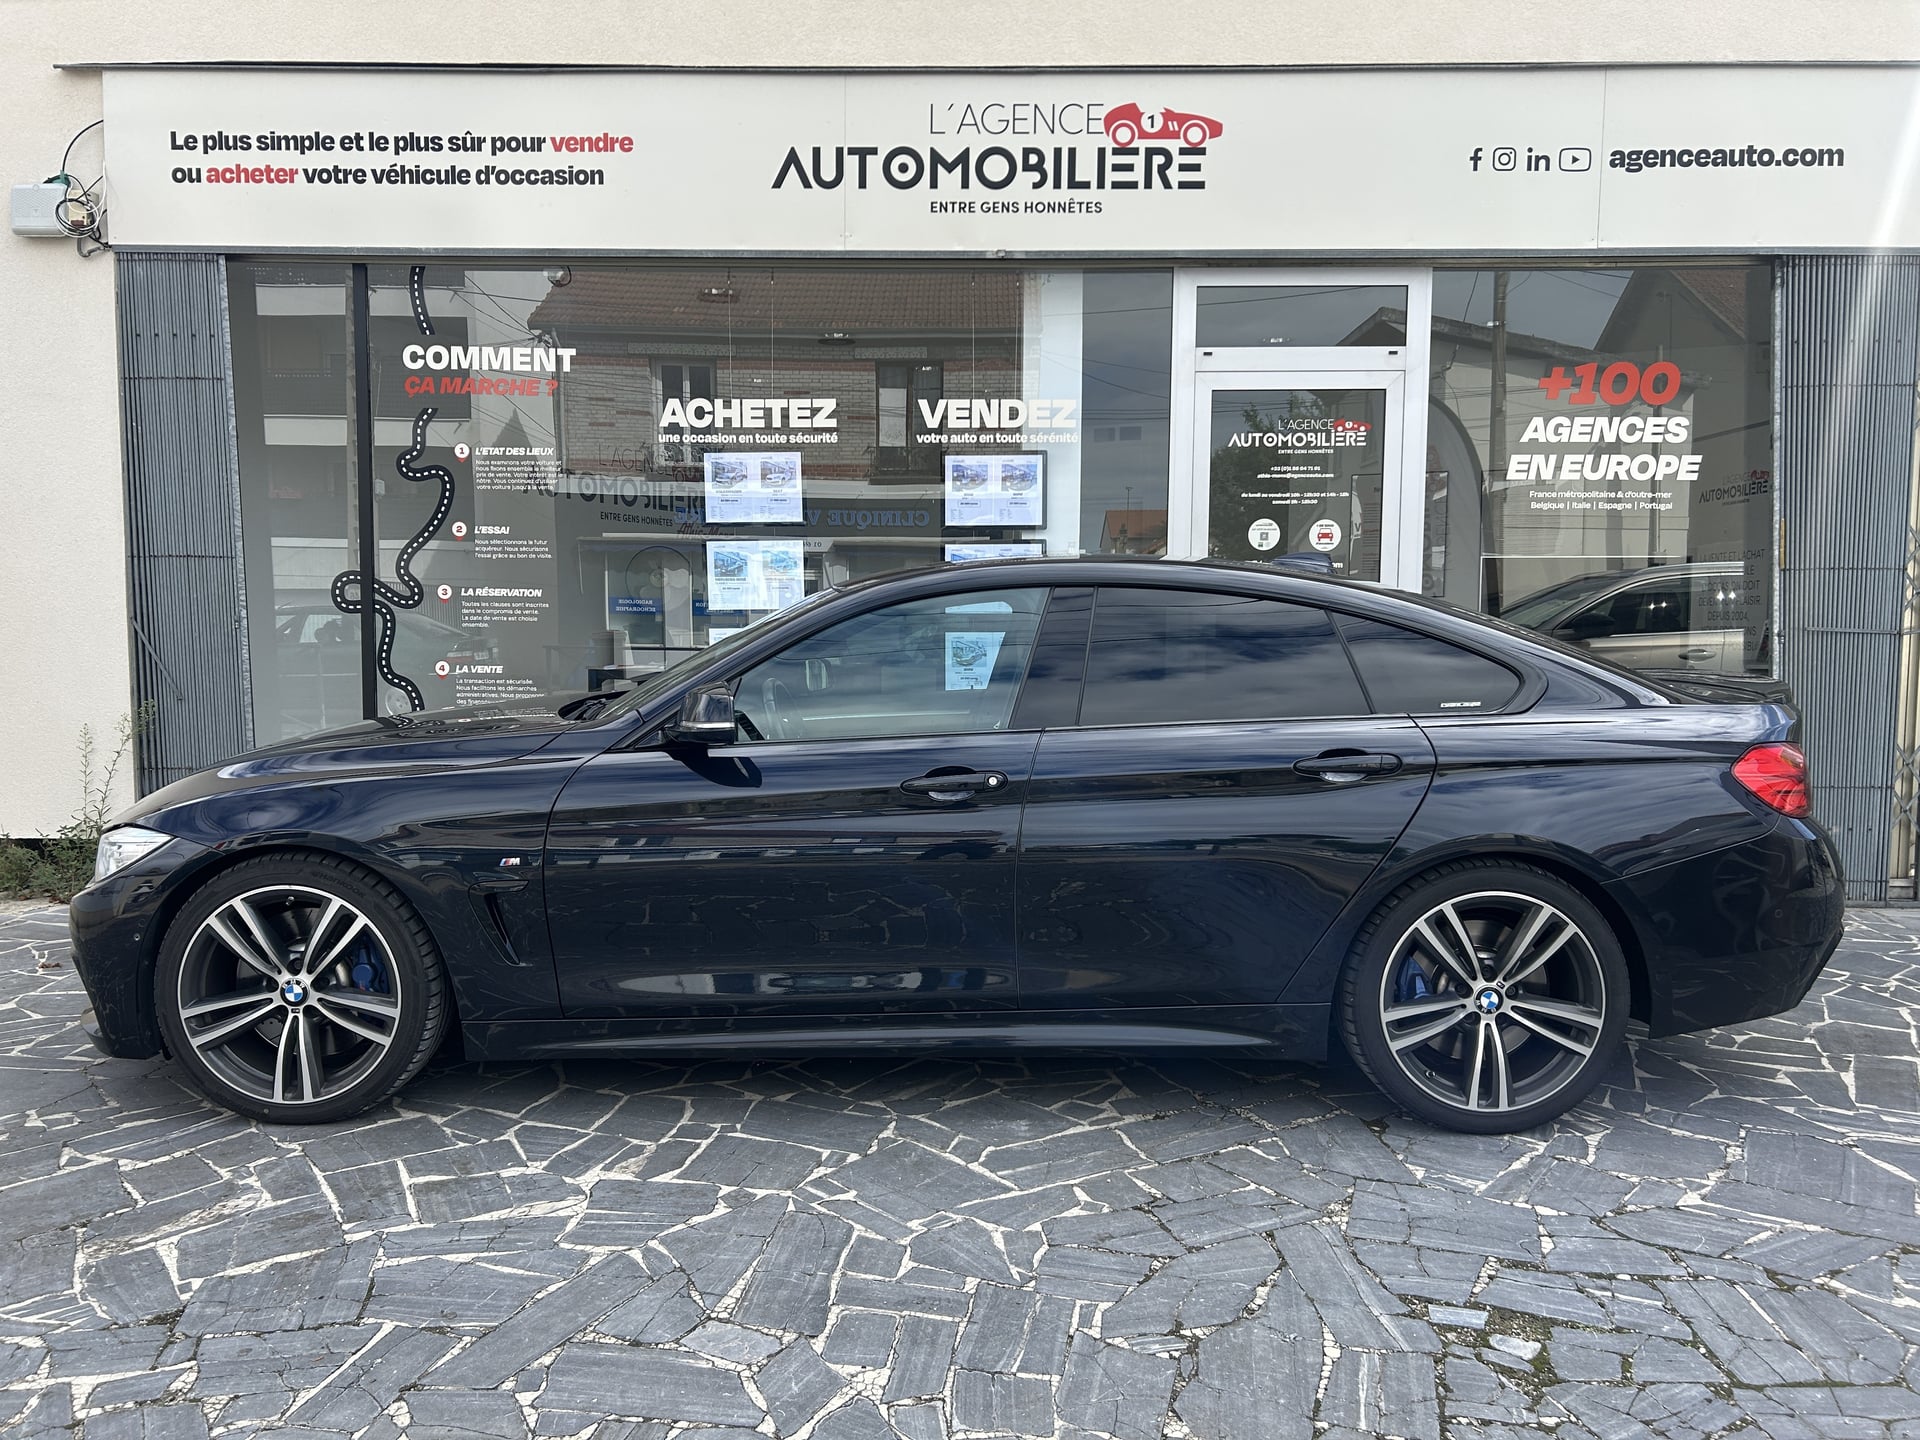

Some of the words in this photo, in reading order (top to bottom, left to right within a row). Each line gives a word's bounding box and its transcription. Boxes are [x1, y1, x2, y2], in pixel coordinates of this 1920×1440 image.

[930, 103, 1104, 135] L'AGENCE
[170, 130, 198, 151] Le
[202, 130, 252, 155] plus
[256, 130, 335, 155] simple
[339, 133, 364, 152] et
[368, 131, 389, 152] le
[394, 130, 443, 155] plus
[448, 130, 486, 153] sûr
[491, 135, 546, 157] pour
[550, 132, 634, 154] vendre
[1609, 145, 1845, 173] agenceauto.com
[171, 167, 202, 185] ou
[206, 164, 299, 185] acheter
[303, 166, 367, 185] votre
[372, 162, 471, 185] véhicule
[475, 164, 604, 186] d'occasion
[930, 201, 976, 214] ENTRE
[980, 201, 1020, 214] GENS
[1023, 198, 1103, 214] HONNÊTES
[402, 345, 577, 372] COMMENT
[404, 376, 435, 398] ÇA
[440, 377, 541, 396] MARCHE
[1538, 361, 1682, 406] +100
[658, 398, 838, 429] ACHETEZ
[916, 399, 1078, 429] VENDEZ
[1278, 419, 1334, 430] L'AGENCE
[1520, 416, 1690, 443] AGENCES
[658, 434, 681, 443] une
[683, 433, 737, 443] occasion
[739, 434, 753, 443] en
[755, 433, 787, 443] toute
[789, 432, 839, 443] sécurité
[916, 434, 948, 443] votre
[950, 434, 978, 443] auto
[980, 434, 994, 443] en
[995, 433, 1028, 443] toute
[1029, 432, 1079, 443] sérénité
[505, 447, 525, 455] DES
[526, 447, 554, 455] LIEUX
[1506, 454, 1558, 481] EN
[1559, 454, 1703, 481] EUROPE
[1529, 490, 1557, 498] France
[1558, 490, 1615, 499] métropolitaine
[1616, 490, 1624, 498] &
[1625, 490, 1672, 498] d'outre-mer
[1530, 501, 1565, 510] Belgique
[1571, 501, 1591, 510] Italie
[1598, 501, 1632, 510] Espagne
[1639, 501, 1673, 510] Portugal
[600, 511, 621, 522] ENTRE
[622, 514, 640, 524] GENS
[474, 526, 510, 534] L'ESSAI
[461, 588, 474, 596] LA
[475, 587, 542, 597] RÉSERVATION
[456, 665, 469, 673] LA
[470, 665, 504, 674] VENTE
